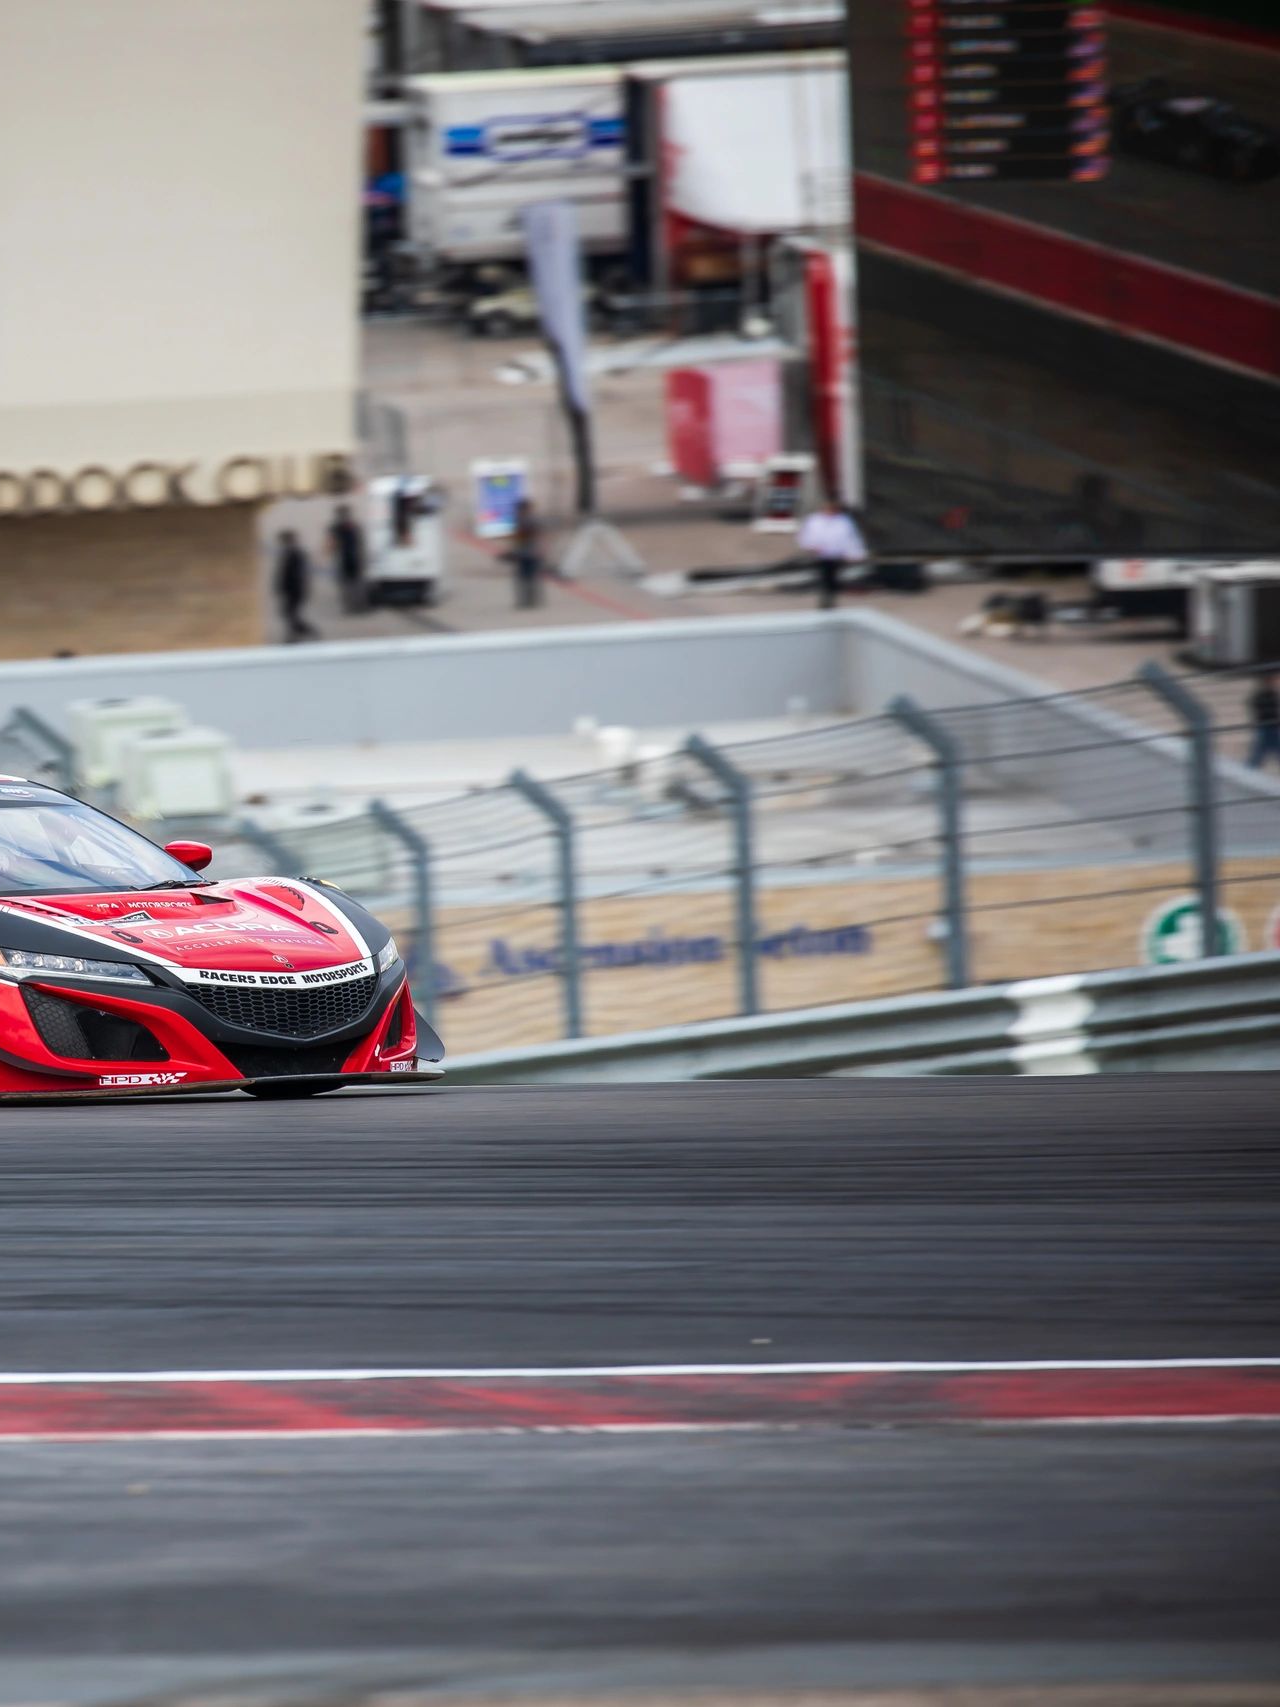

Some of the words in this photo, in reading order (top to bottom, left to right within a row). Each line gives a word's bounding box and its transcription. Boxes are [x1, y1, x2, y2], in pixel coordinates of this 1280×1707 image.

[175, 923, 298, 936] ACURA
[176, 938, 264, 951] ACCELERATED
[269, 937, 324, 945] SERVICE
[199, 970, 257, 984] RACERS
[260, 975, 297, 985] EDGE
[301, 961, 369, 984] MOTORSPORTS
[100, 1075, 143, 1085] HPD
